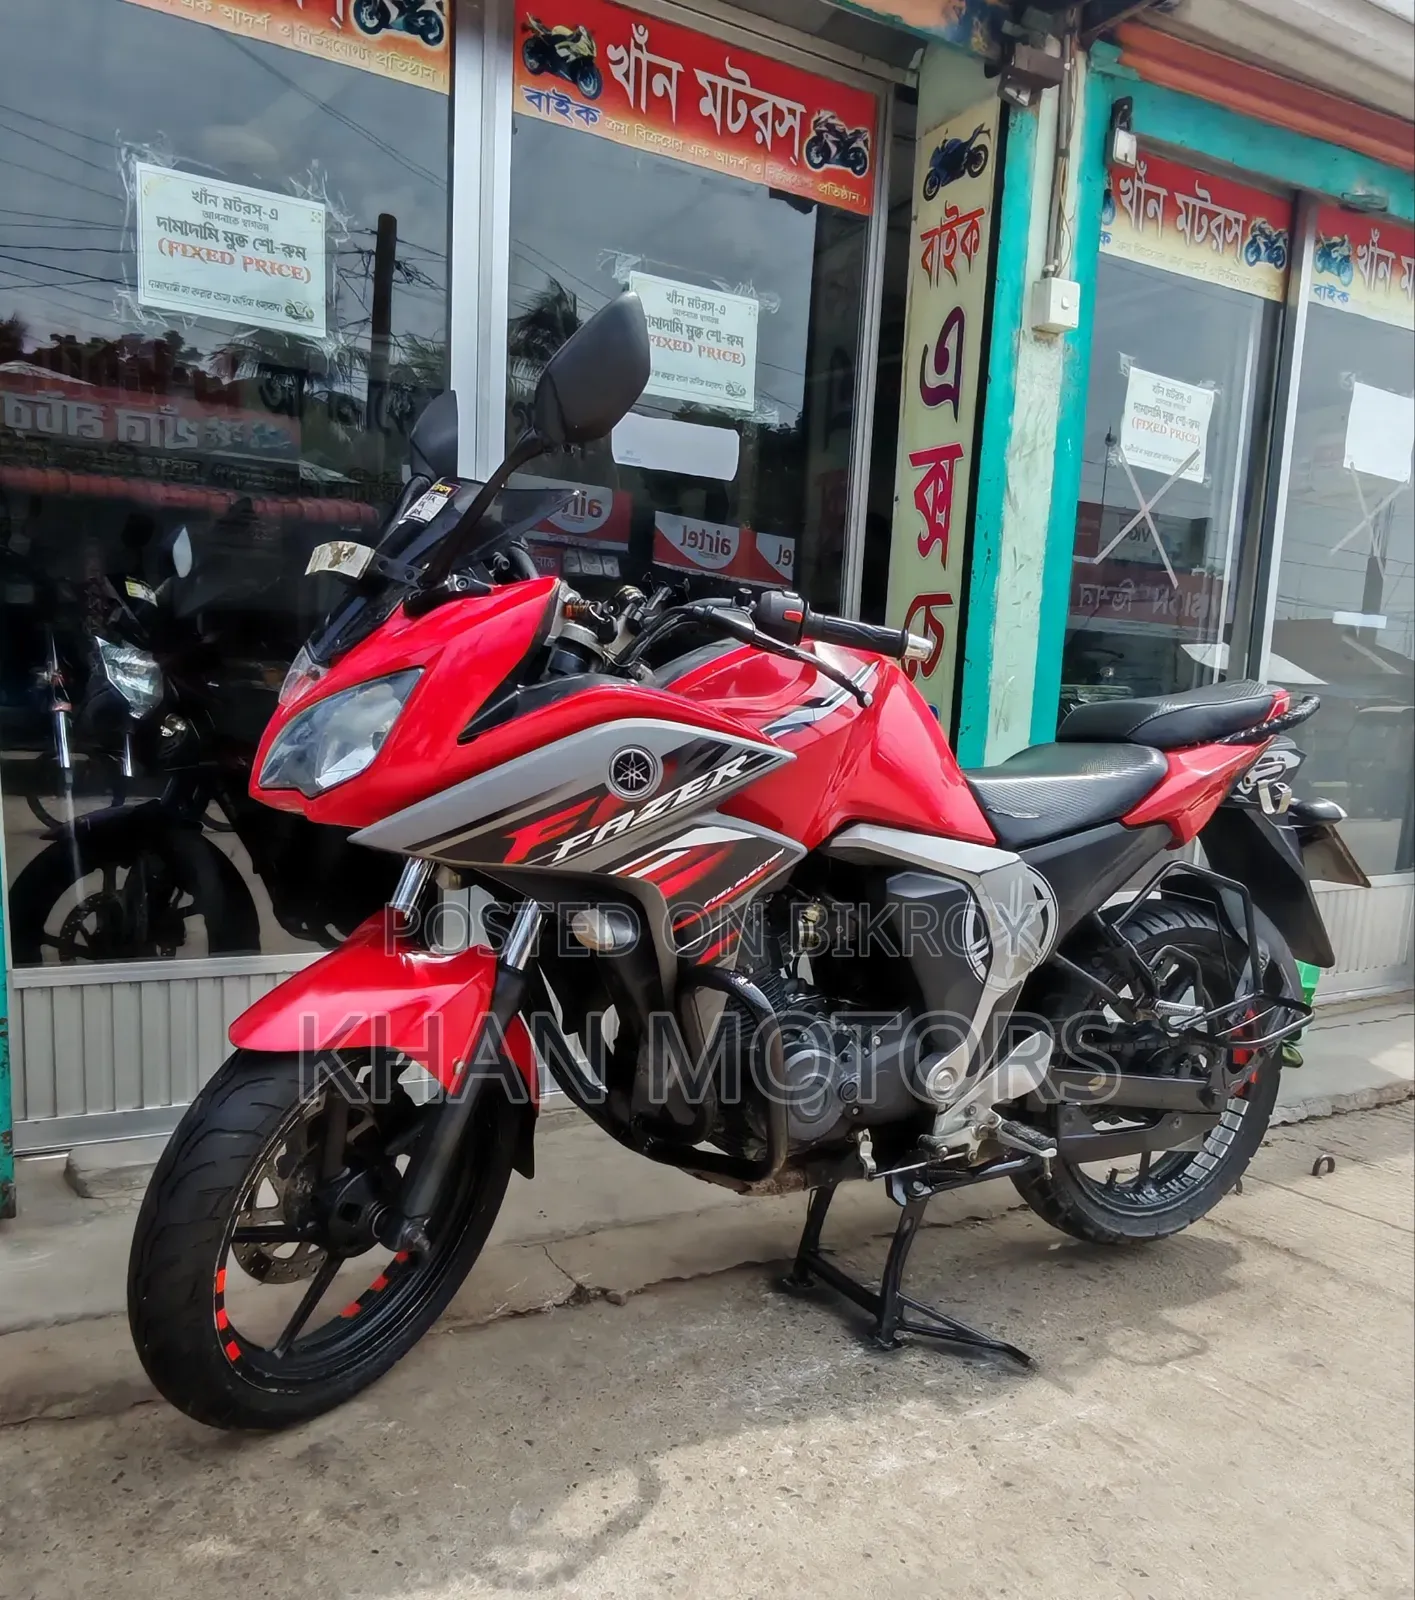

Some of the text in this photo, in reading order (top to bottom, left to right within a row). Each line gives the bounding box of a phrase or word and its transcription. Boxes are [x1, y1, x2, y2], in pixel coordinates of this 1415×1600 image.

[219, 4, 271, 31] আদর্শ
[522, 85, 602, 129] বাইক
[714, 150, 748, 171] আদর্শ
[606, 23, 806, 166] খাঁন মটরস্
[156, 216, 220, 243] দামাদামি
[1119, 159, 1168, 240] খাঁন
[157, 237, 311, 285] (FIXED PRICE)
[920, 200, 985, 290] বাইক
[1357, 227, 1396, 292] খাঁন
[645, 313, 683, 335] ামাদামি
[552, 753, 750, 862] FAZER
